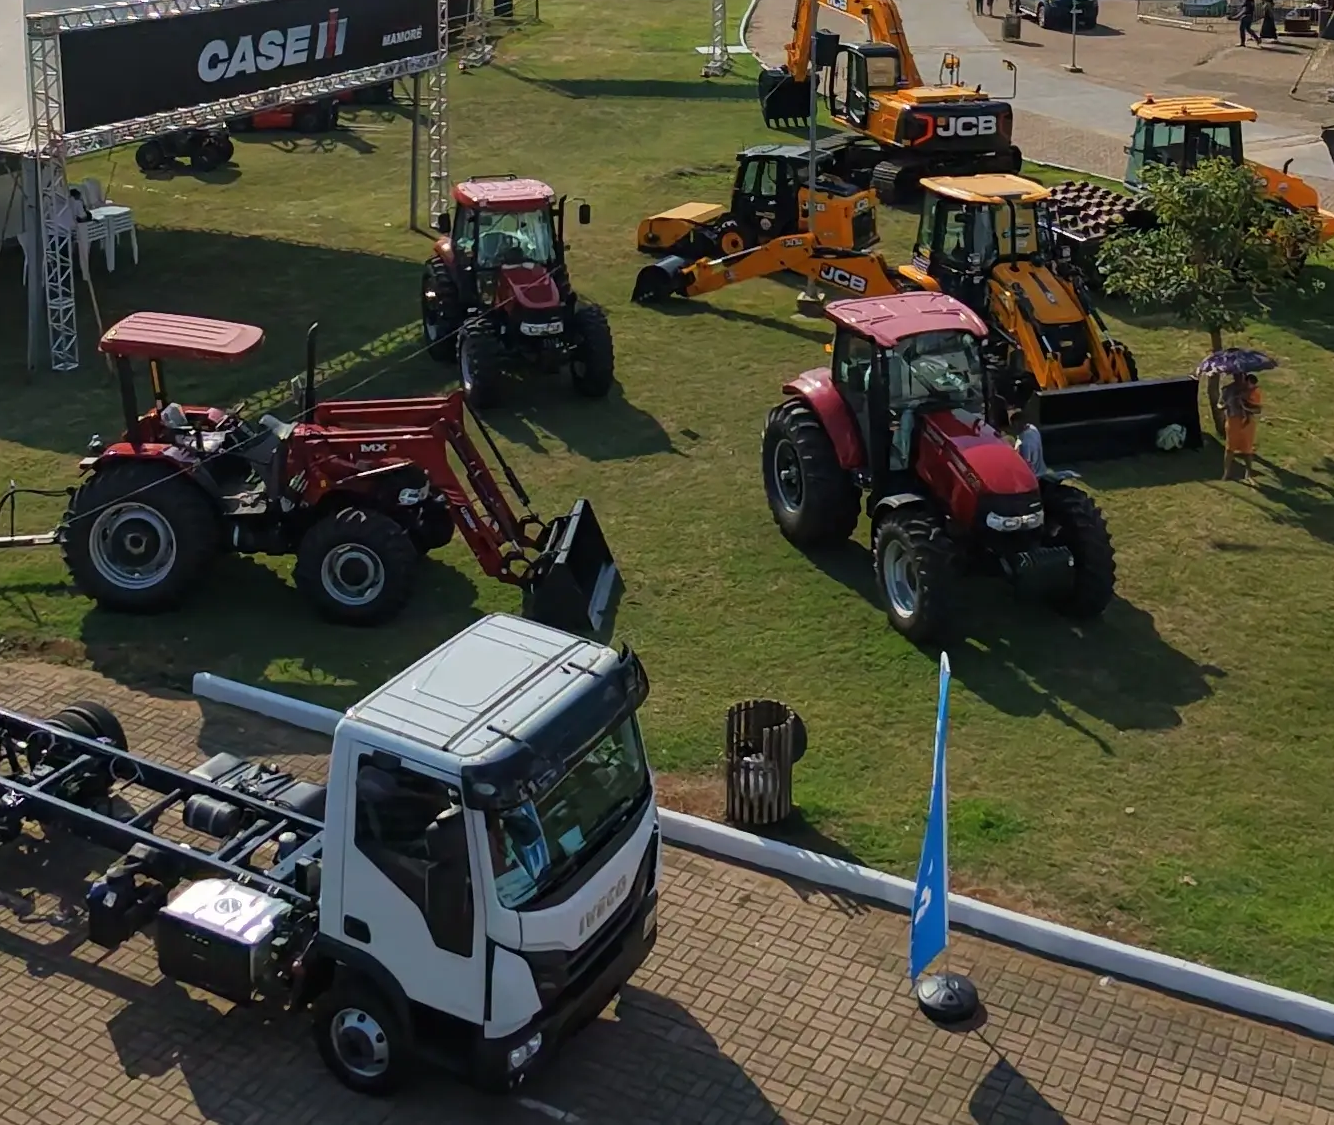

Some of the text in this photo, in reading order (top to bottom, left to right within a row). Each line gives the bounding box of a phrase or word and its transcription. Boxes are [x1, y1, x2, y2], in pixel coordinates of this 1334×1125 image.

[197, 24, 312, 83] CASE
[936, 115, 997, 137] JCB
[820, 265, 867, 293] JCB
[360, 443, 388, 453] MX
[578, 874, 627, 937] IVECO
